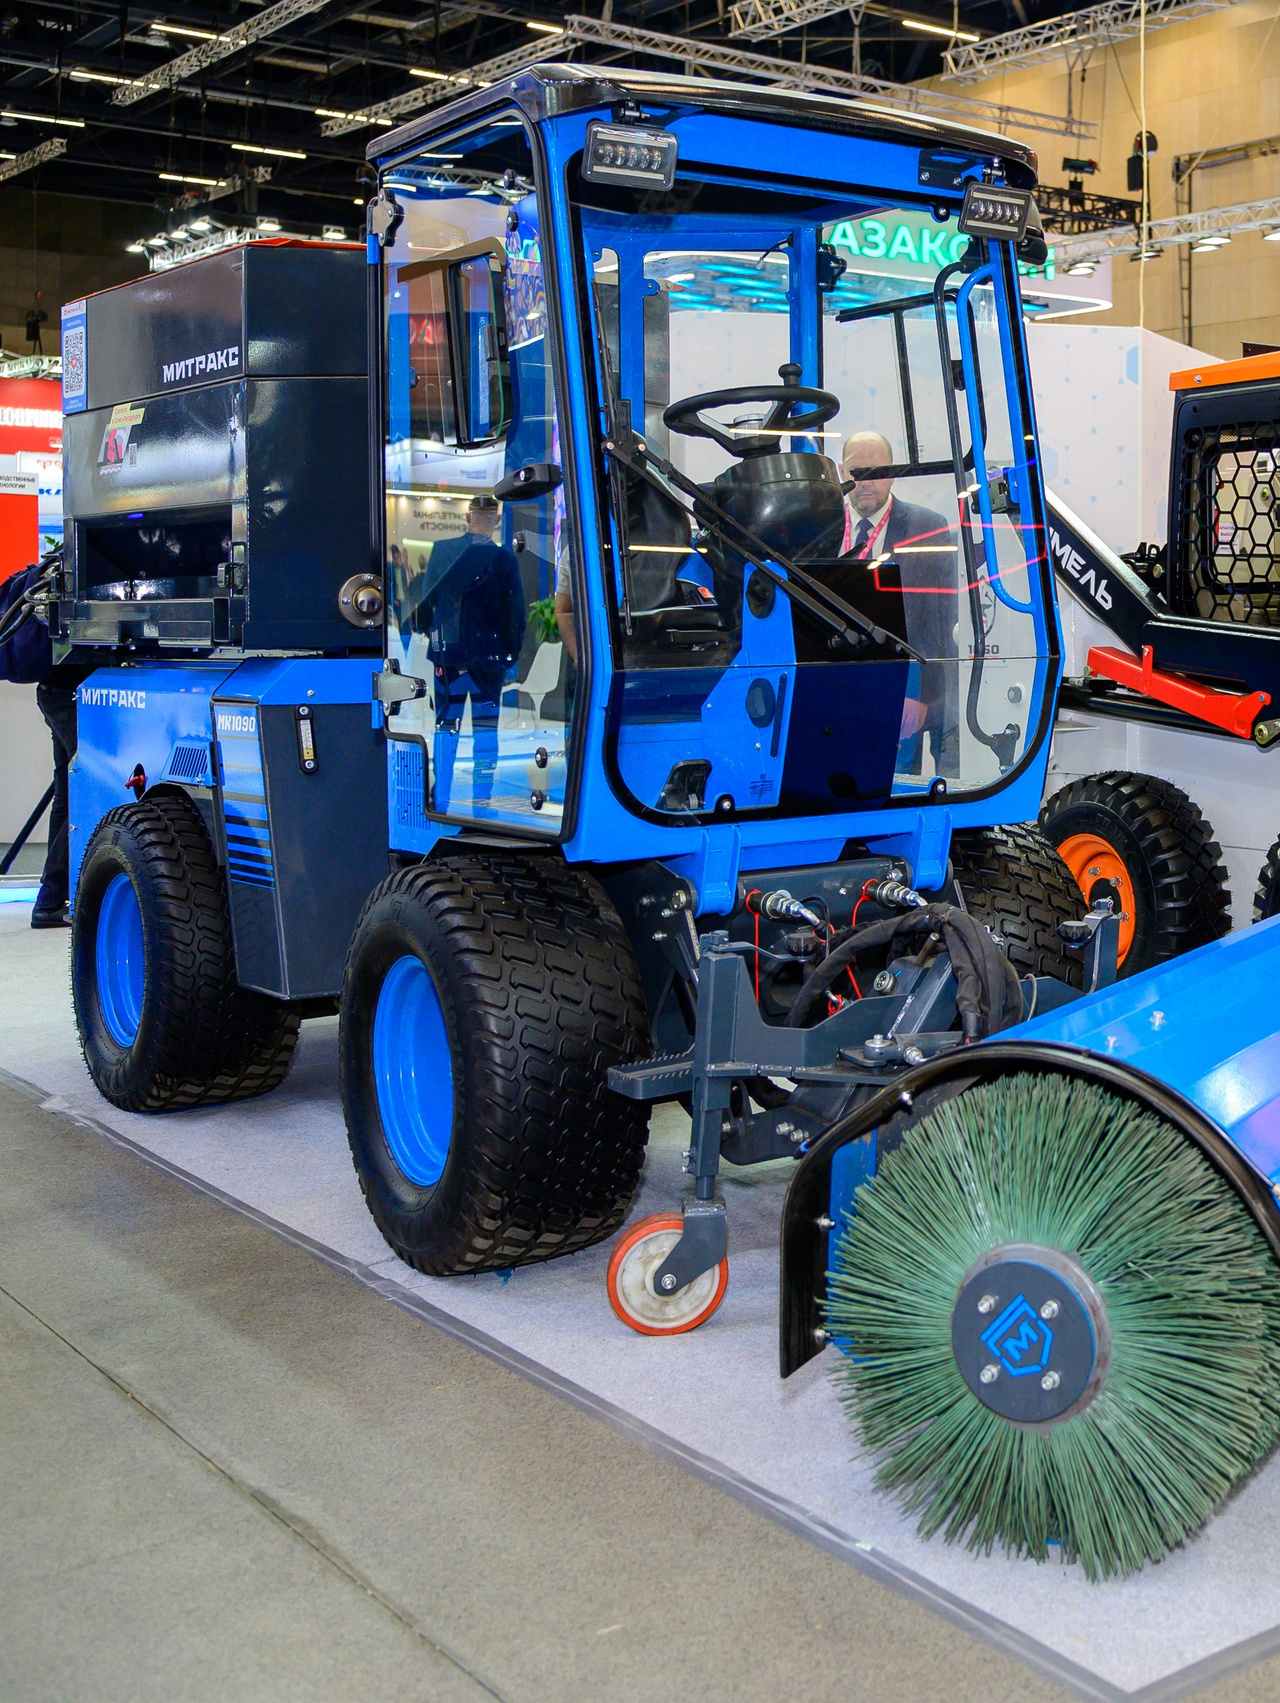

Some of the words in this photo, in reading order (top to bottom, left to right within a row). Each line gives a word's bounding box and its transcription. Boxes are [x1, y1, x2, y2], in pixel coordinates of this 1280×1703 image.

[162, 346, 239, 384] МИТРАКС
[1049, 526, 1112, 611] МЕЛЬ
[81, 687, 146, 709] МИТРАКС
[217, 714, 256, 733] МК1090
